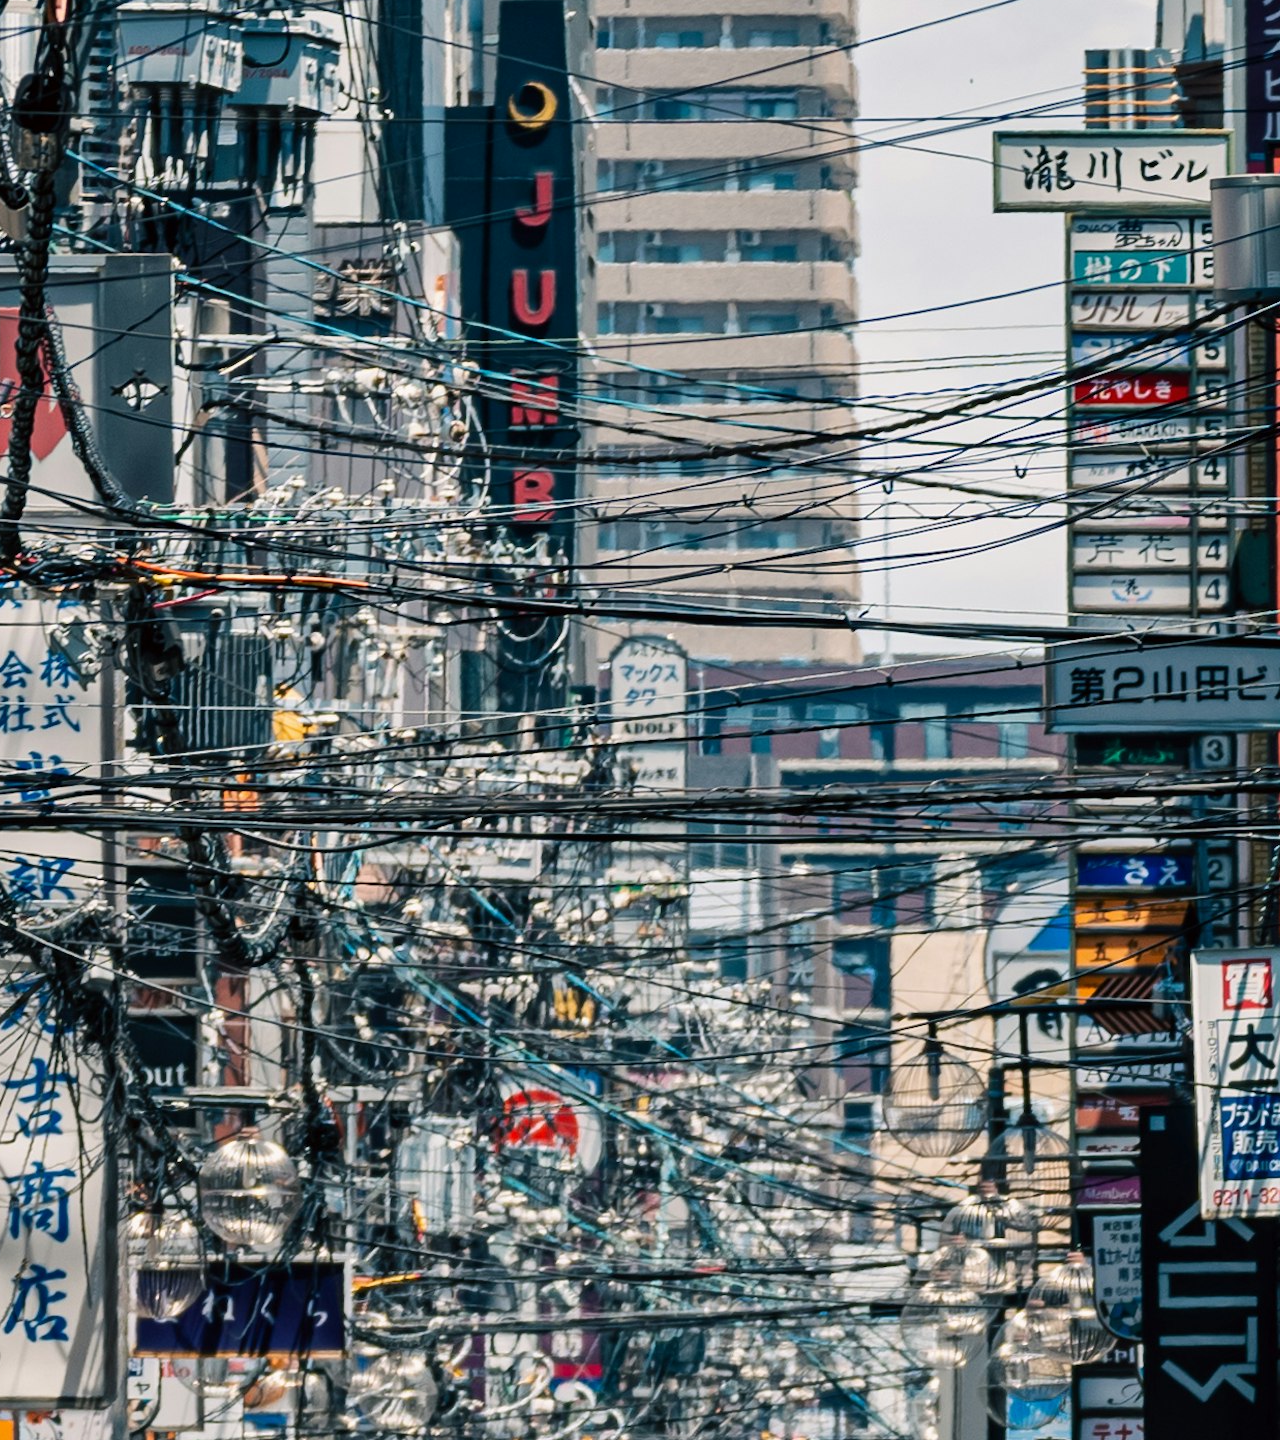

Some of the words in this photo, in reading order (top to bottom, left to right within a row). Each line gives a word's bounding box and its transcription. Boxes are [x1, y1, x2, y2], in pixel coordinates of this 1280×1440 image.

[1084, 254, 1175, 283] 樹の下
[1205, 538, 1222, 560] 4
[1205, 578, 1221, 600] 4
[1206, 739, 1224, 762] 3
[1122, 858, 1187, 886] さえ
[1224, 962, 1270, 1009] 質
[1231, 1129, 1280, 1156] 販売
